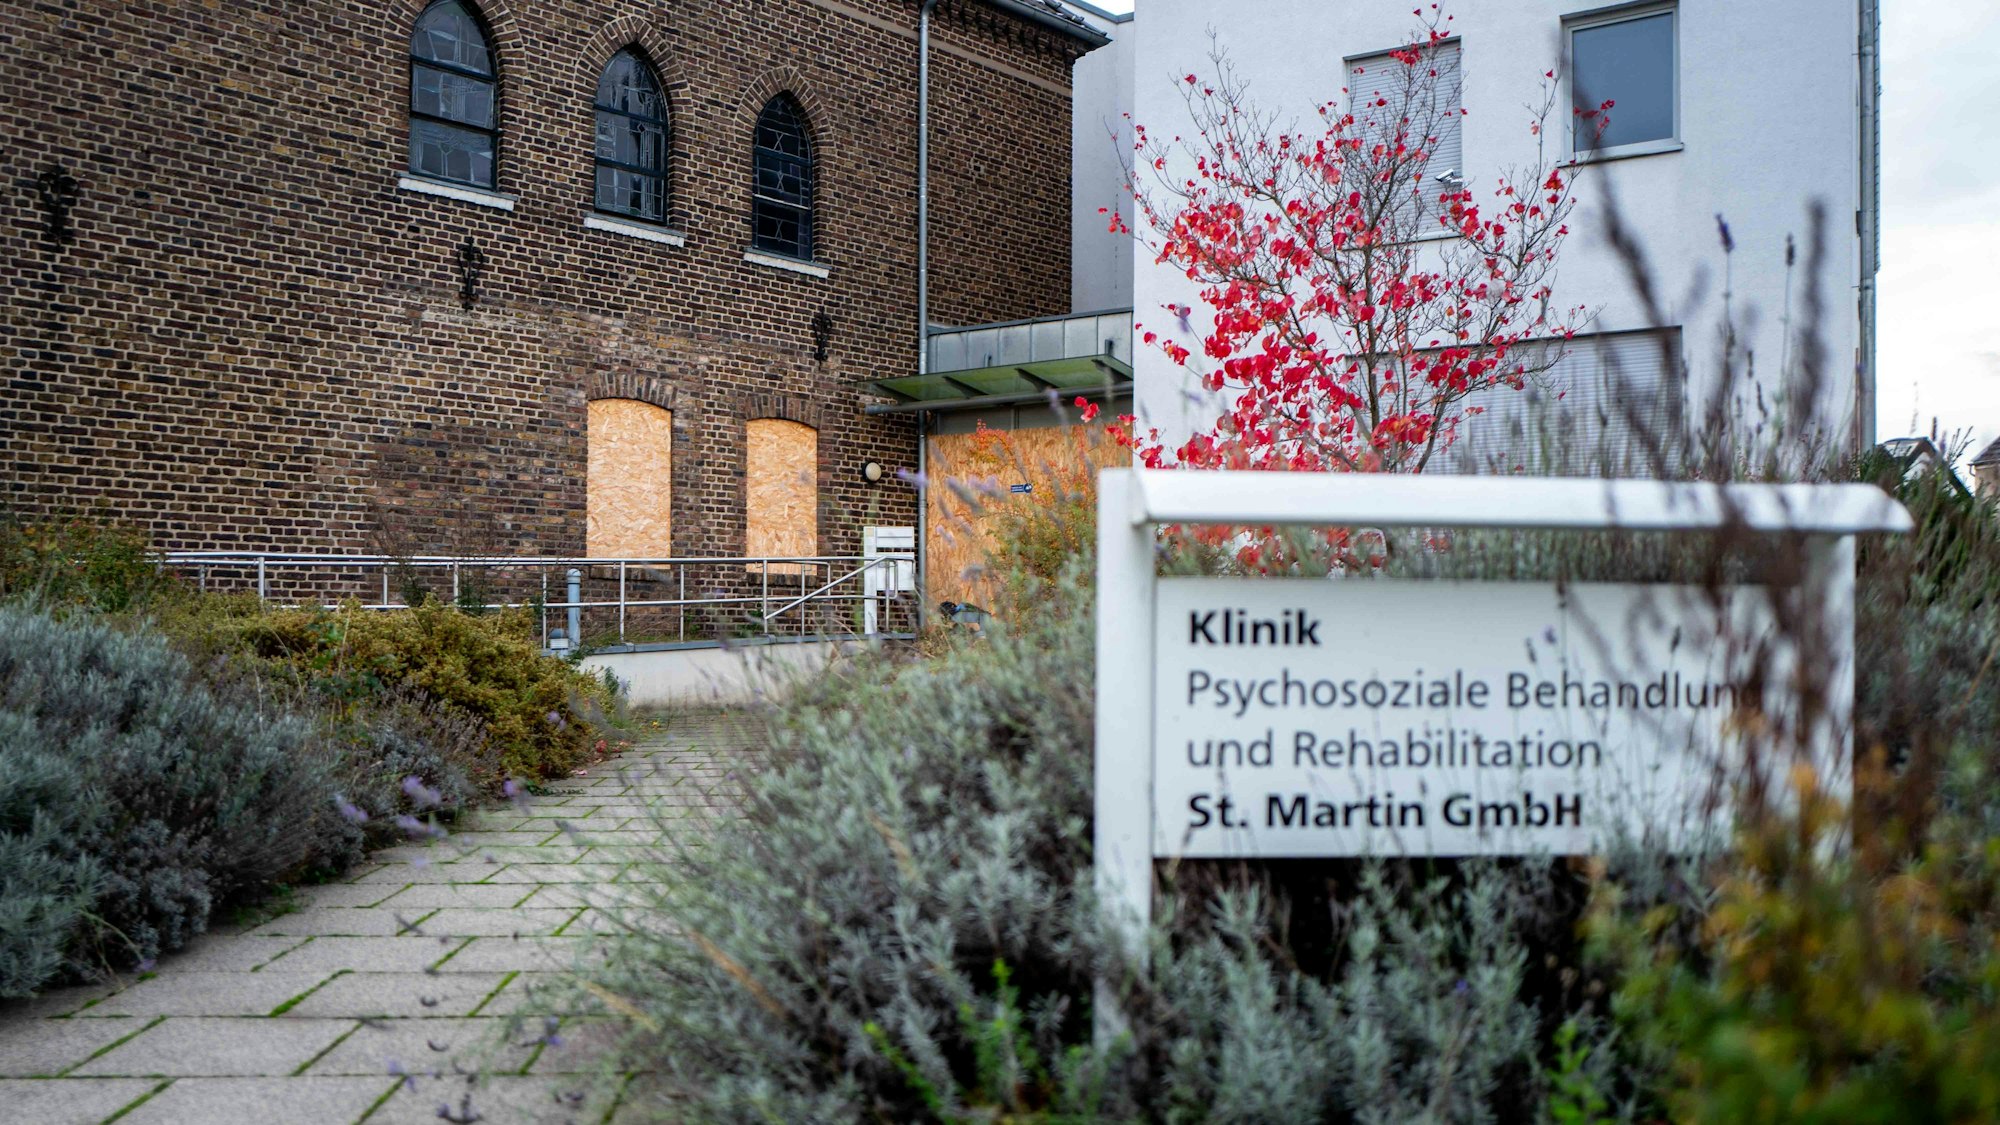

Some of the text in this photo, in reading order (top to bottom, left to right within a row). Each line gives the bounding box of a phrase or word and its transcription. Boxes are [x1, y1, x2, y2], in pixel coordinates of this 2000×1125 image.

[1188, 607, 1322, 646] Klinik
[1187, 667, 1754, 718] Psychosoziale Behandlun
[1186, 727, 1601, 768] und Rehabilitation
[1188, 790, 1582, 829] St. Martin GmbH
